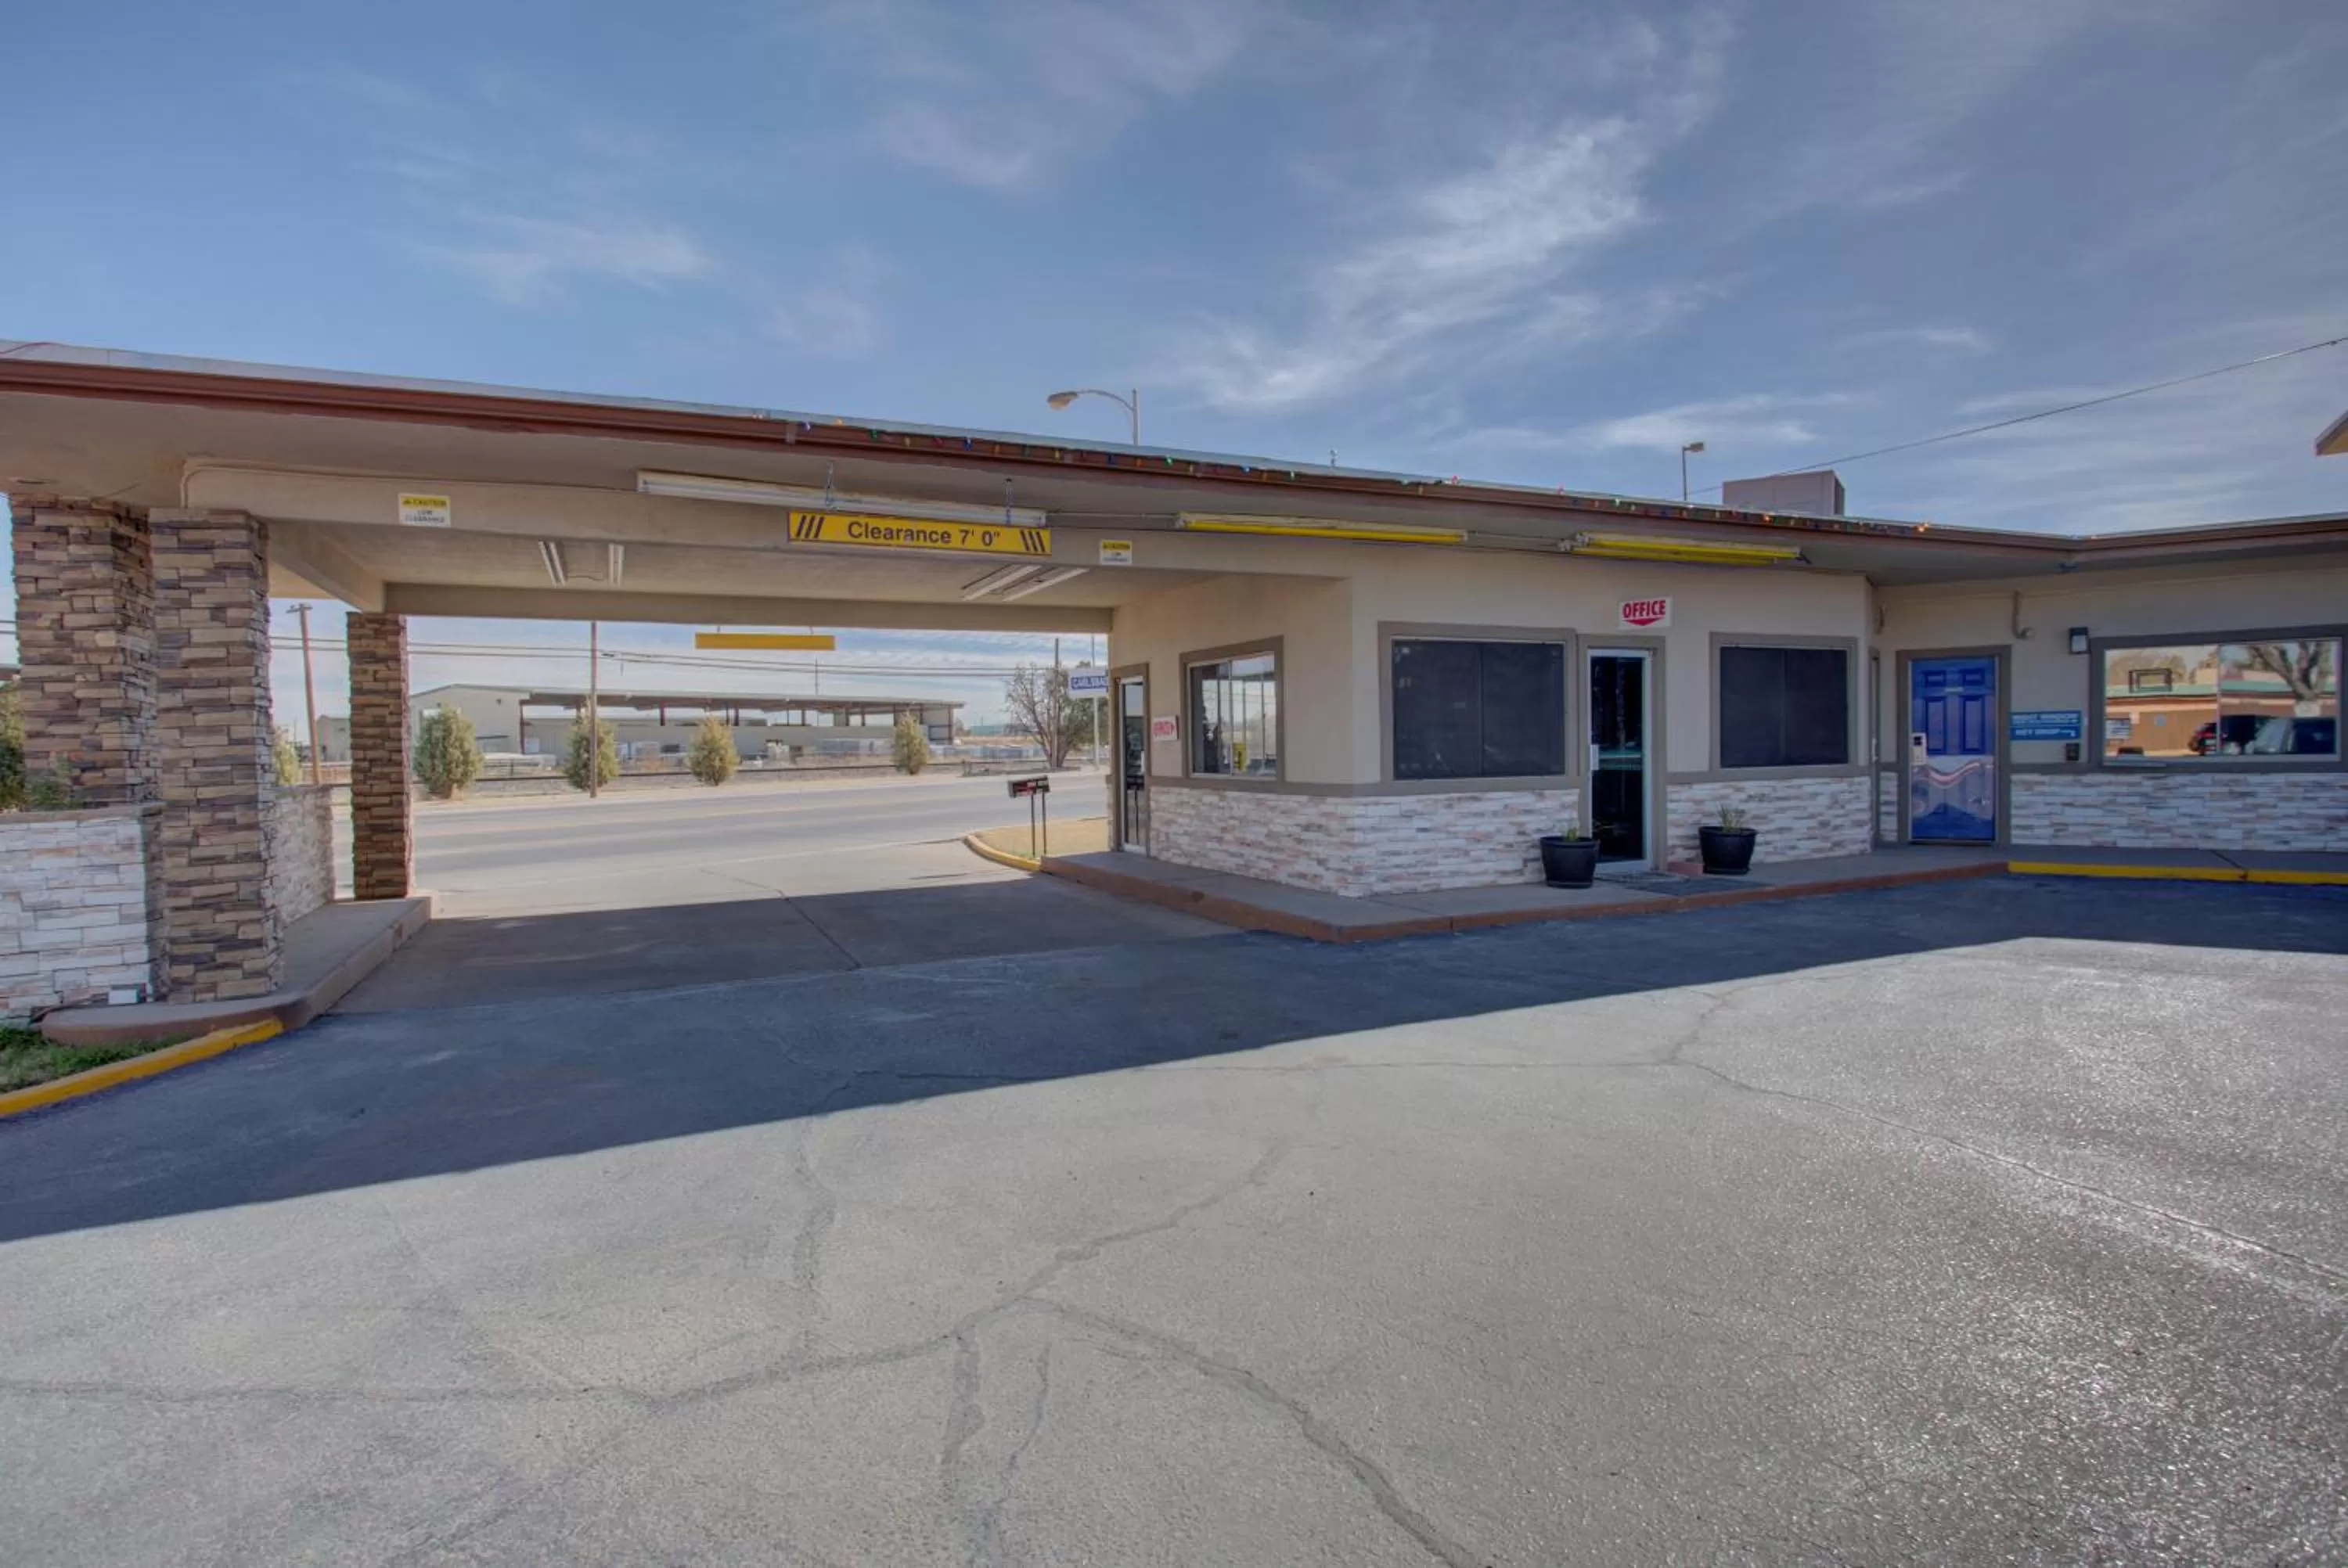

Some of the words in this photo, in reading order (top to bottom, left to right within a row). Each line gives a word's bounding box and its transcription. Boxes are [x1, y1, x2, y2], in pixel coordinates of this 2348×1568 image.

[848, 520, 953, 545] Clearance
[959, 528, 974, 546] 7'
[981, 530, 1001, 547] 0"
[1622, 600, 1666, 619] OFFICE
